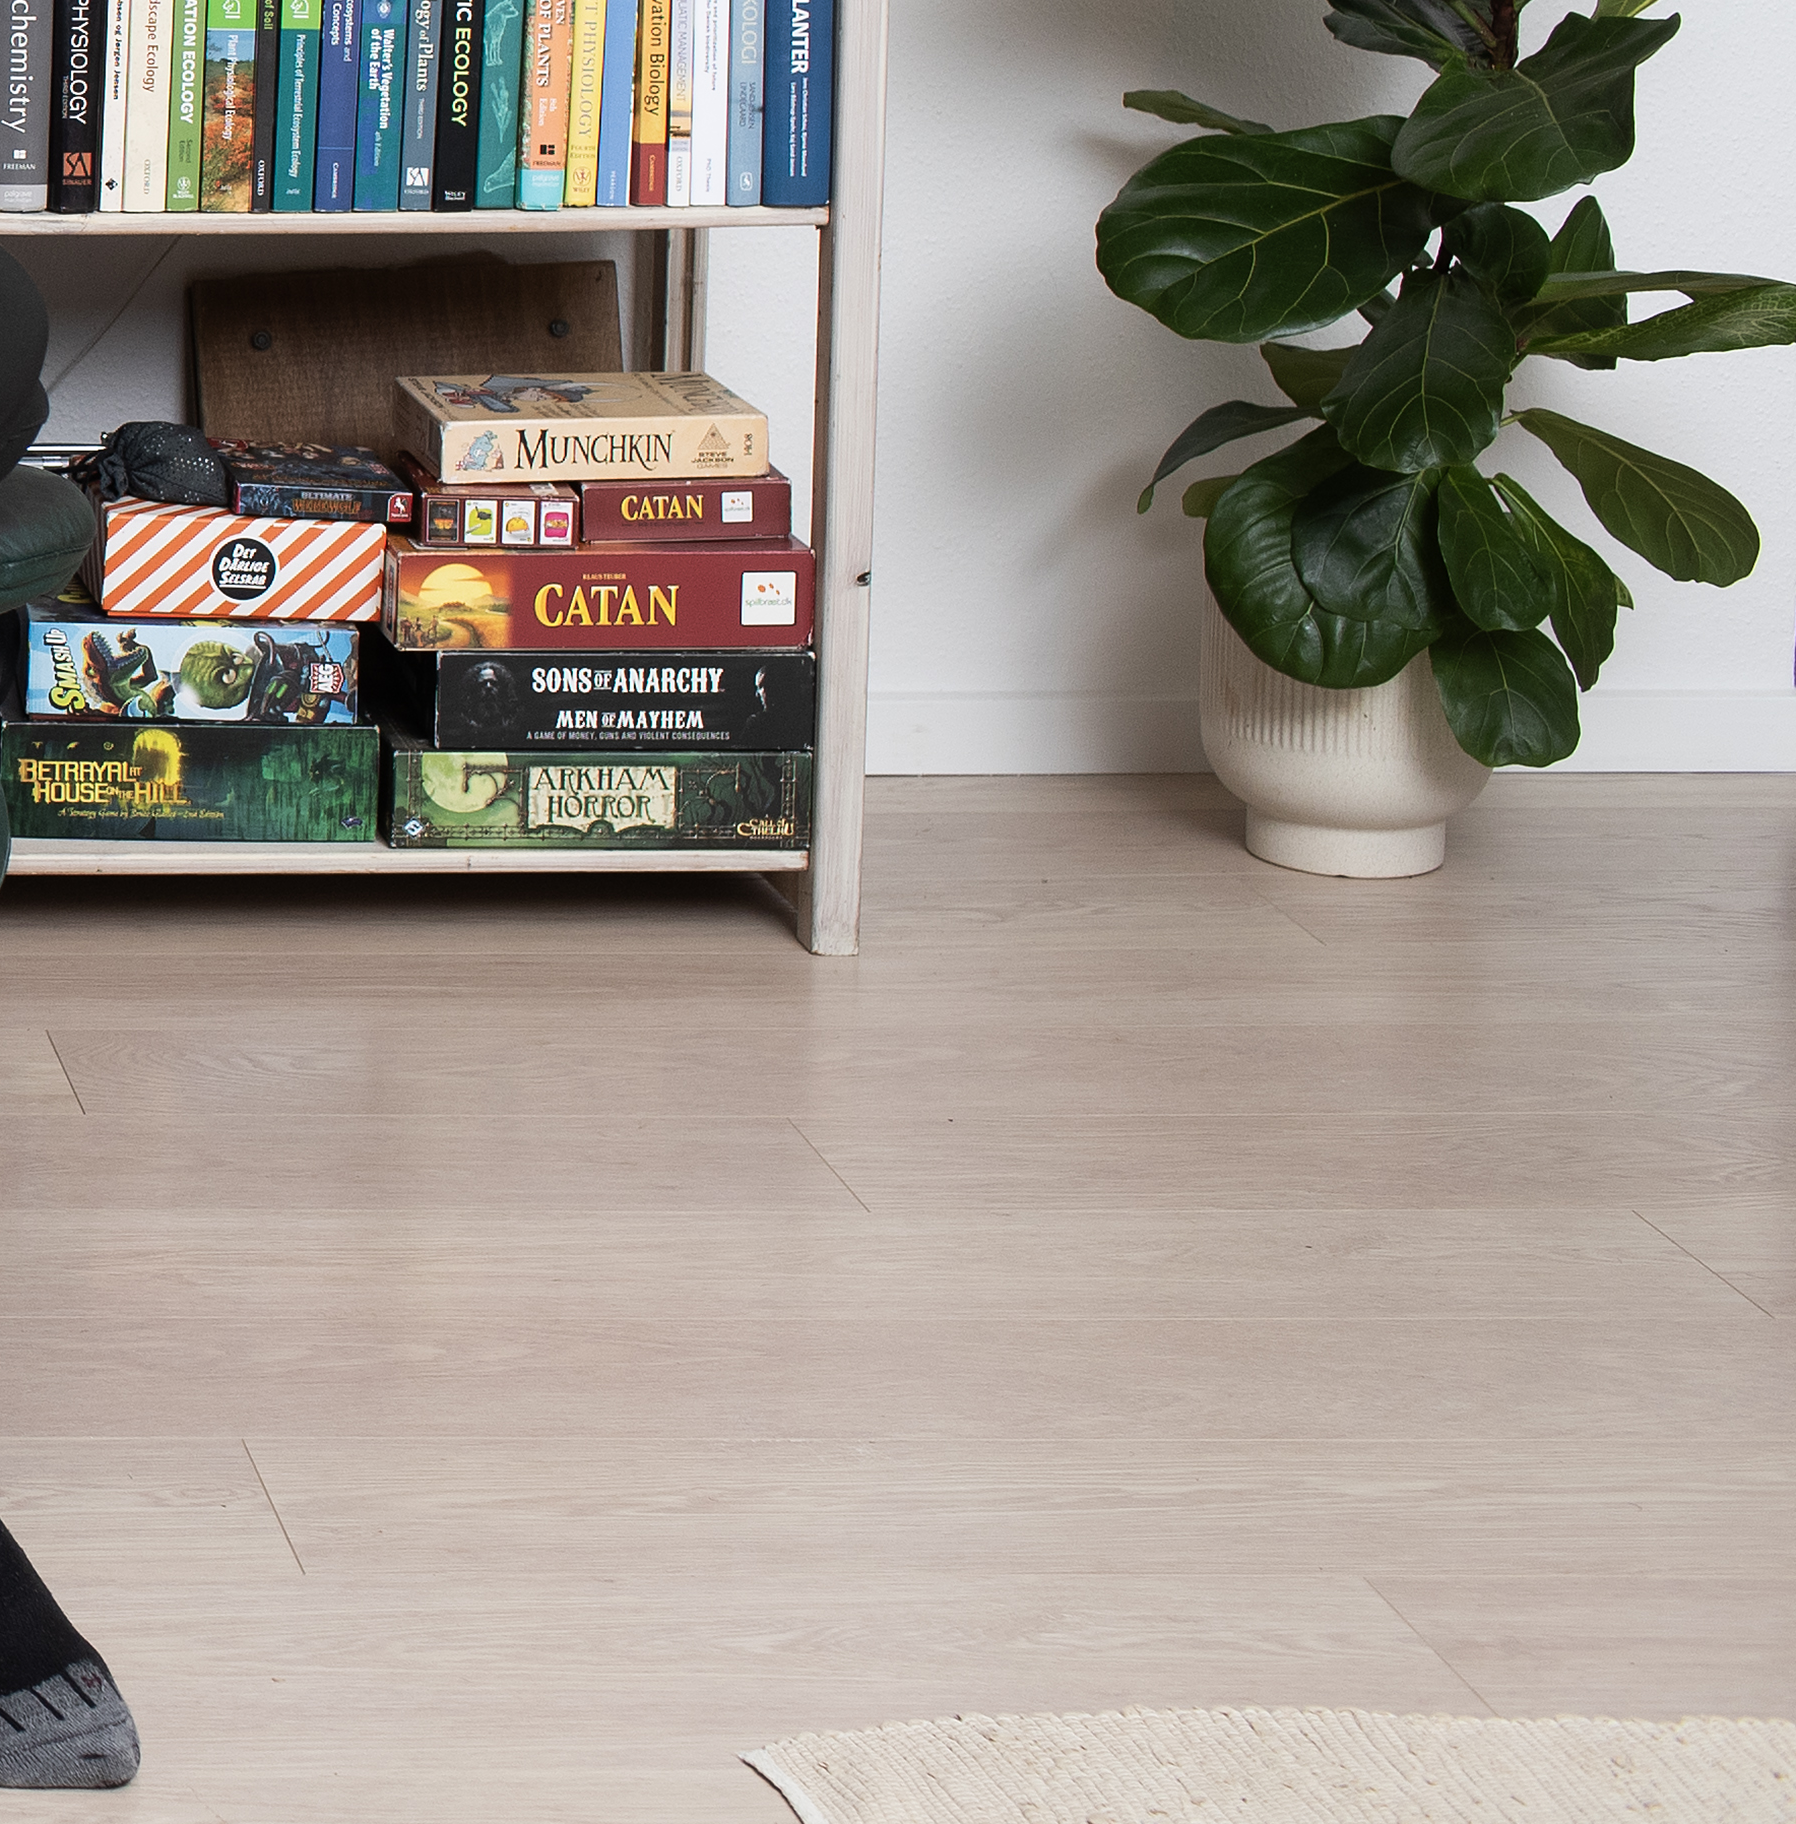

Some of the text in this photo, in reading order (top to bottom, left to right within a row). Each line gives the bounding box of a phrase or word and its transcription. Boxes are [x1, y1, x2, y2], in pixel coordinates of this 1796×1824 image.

[180, 50, 196, 124] ECOLOGY
[450, 26, 472, 127] ECOLOGY
[644, 53, 666, 116] Biology
[515, 427, 674, 470] MUNCHKIN
[620, 495, 704, 521] CATAN
[534, 583, 679, 627] CATAN
[44, 629, 84, 711] SMASH UP
[318, 663, 334, 692] AEG
[532, 668, 723, 693] SONS OF ANARCHY
[555, 710, 703, 729] MEN OF MAYHEM
[18, 758, 133, 784] BETRAYAL
[534, 768, 670, 794] ARKHAM
[32, 781, 108, 804] HOUSE
[547, 795, 656, 822] HORROR
